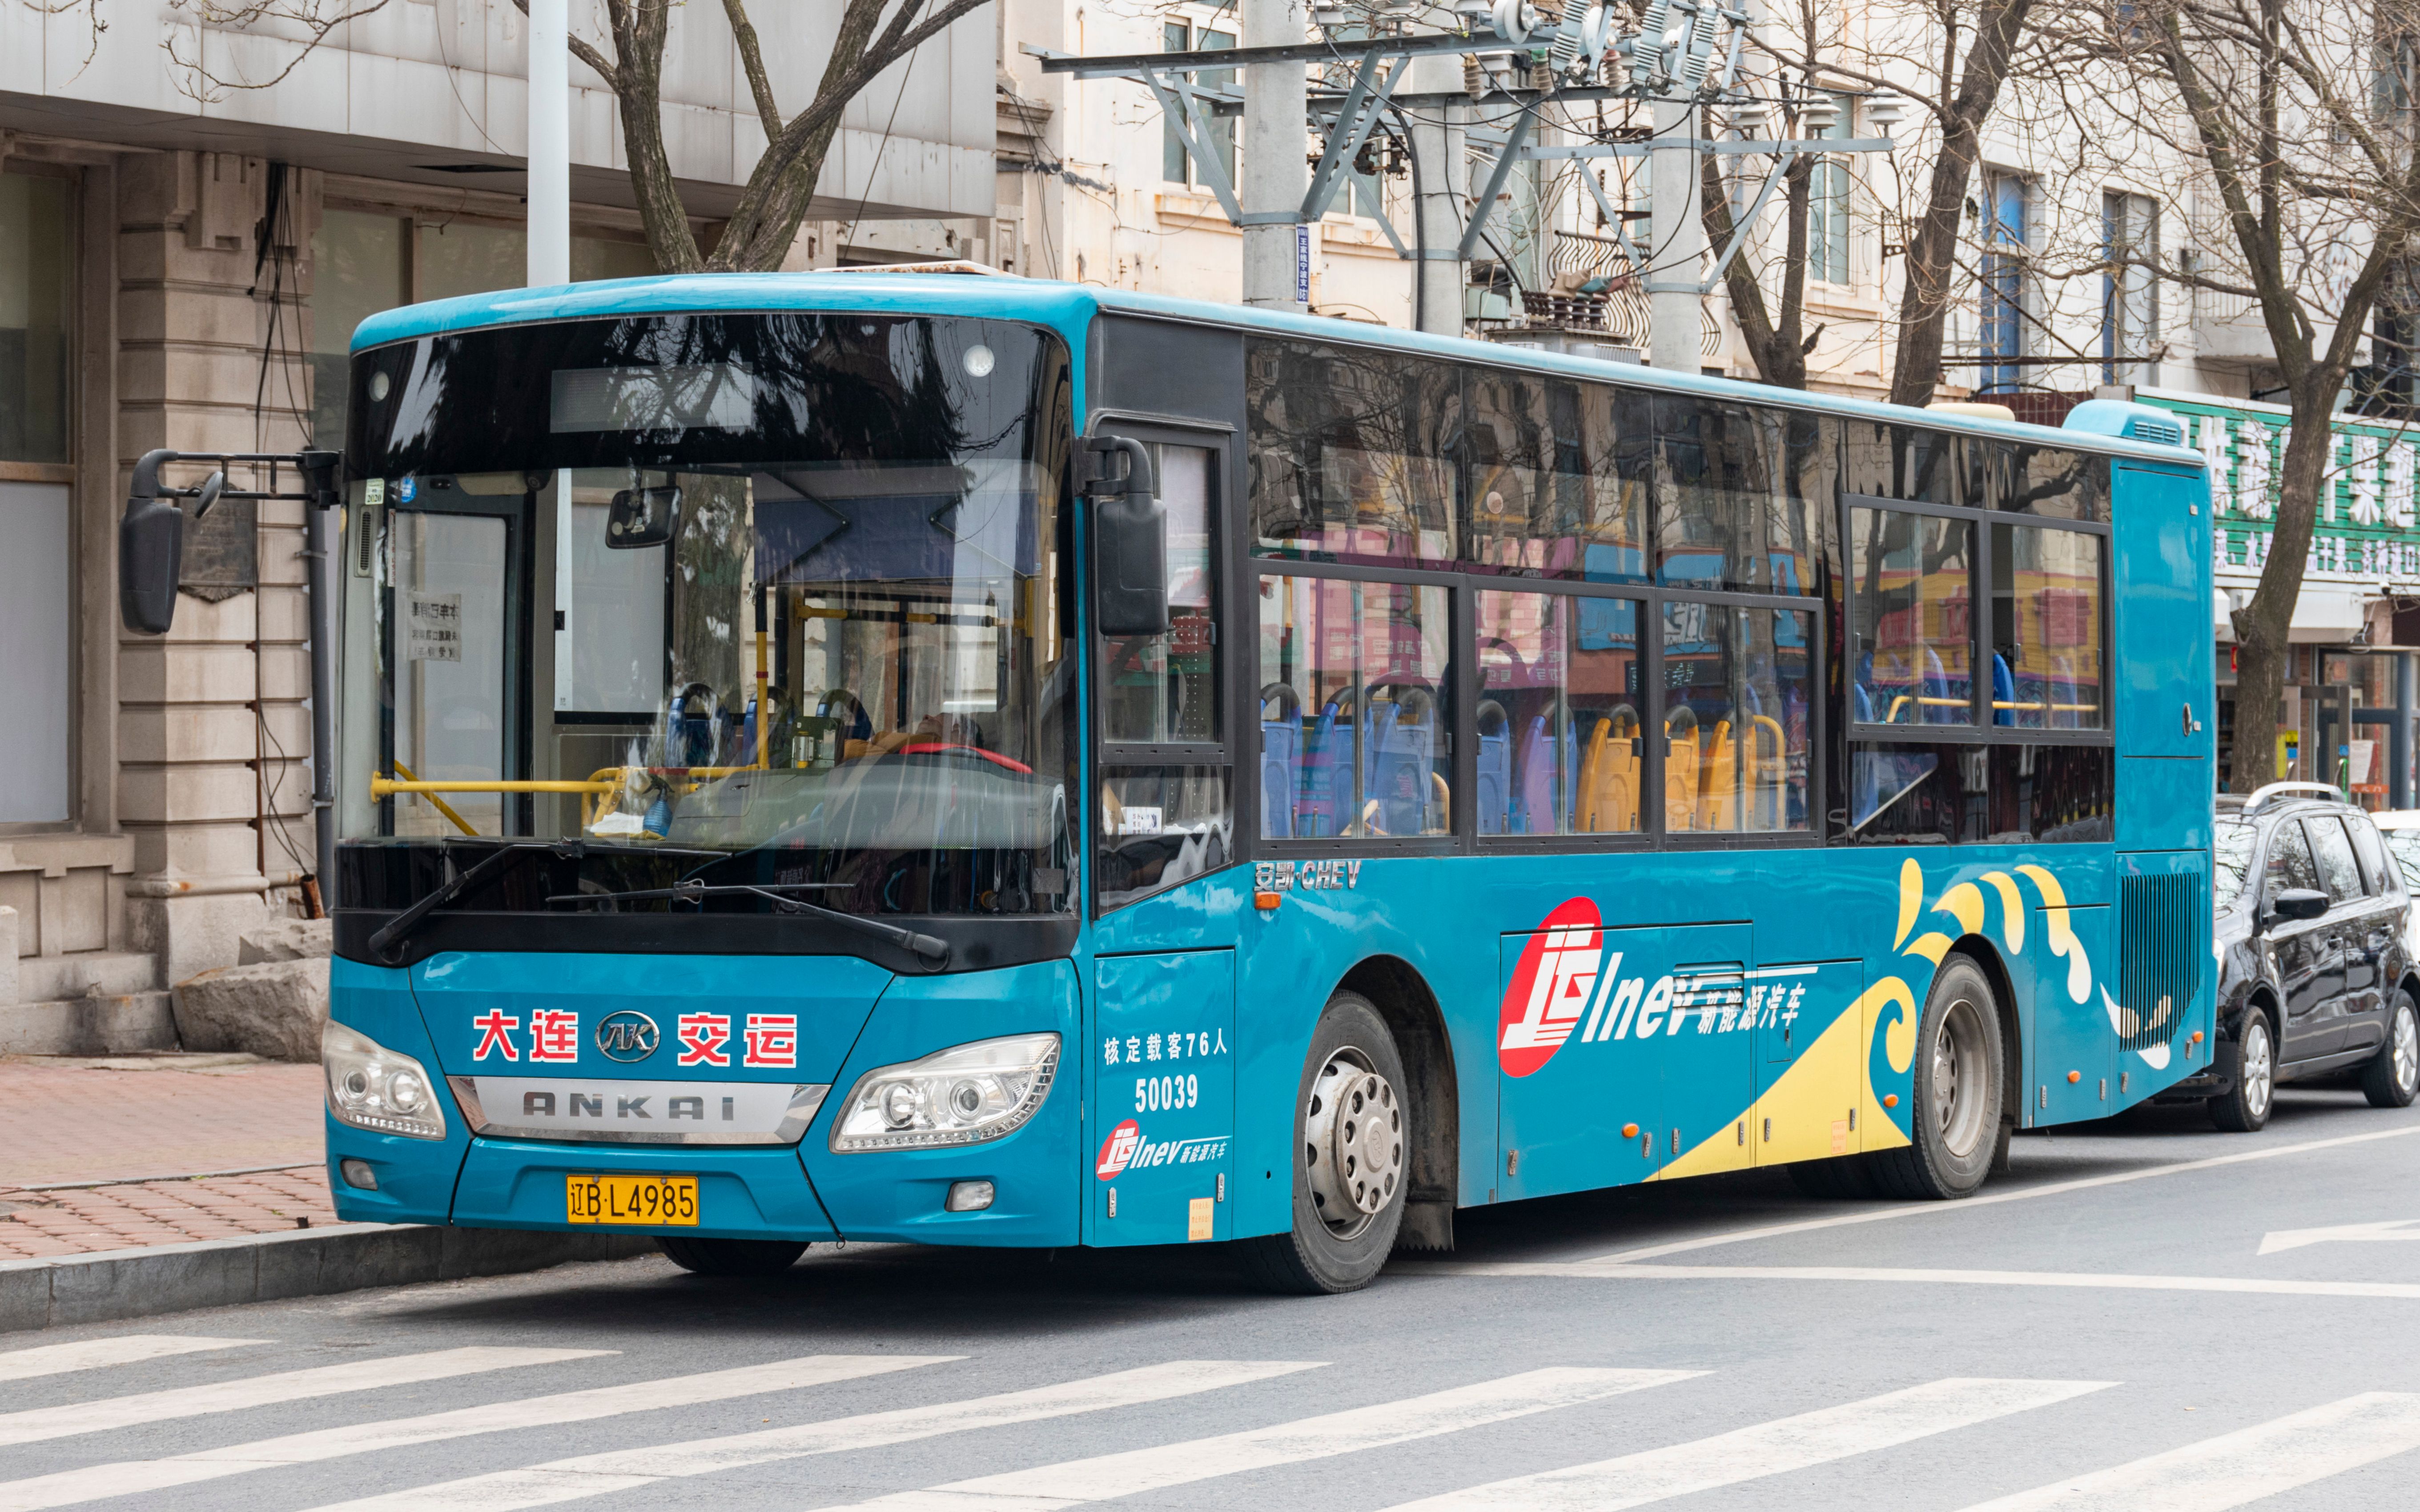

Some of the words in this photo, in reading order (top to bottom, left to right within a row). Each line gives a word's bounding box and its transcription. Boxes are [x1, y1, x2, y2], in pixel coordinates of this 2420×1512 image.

[367, 494, 382, 503] 2020
[473, 1008, 579, 1063] 大连
[677, 1011, 797, 1068] 交运
[1104, 1028, 1227, 1066] 核定载客76人
[523, 1091, 734, 1121] ANKAI
[1135, 1074, 1198, 1113] 50039
[1180, 1141, 1228, 1164] 新能源汽车
